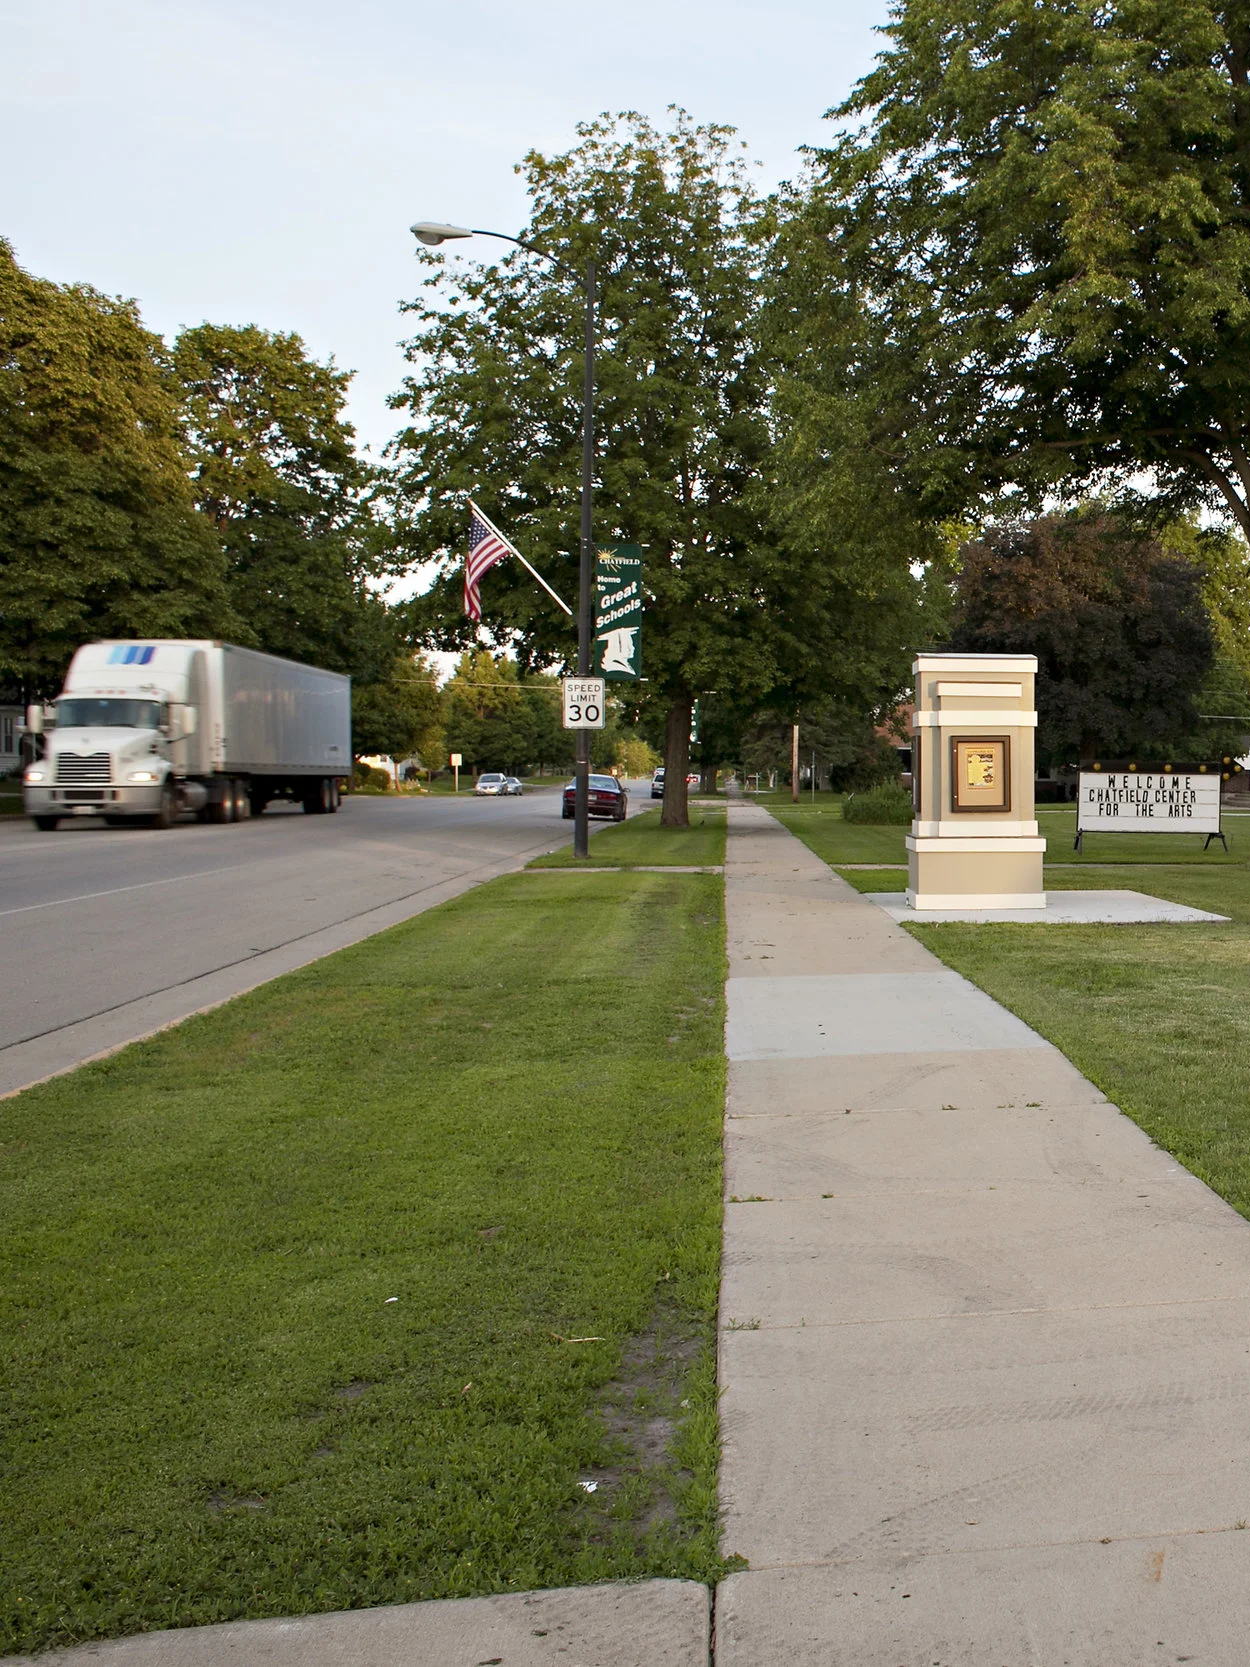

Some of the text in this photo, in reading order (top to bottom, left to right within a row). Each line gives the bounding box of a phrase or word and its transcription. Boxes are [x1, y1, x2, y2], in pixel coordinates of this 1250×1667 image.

[597, 575, 621, 583] Home
[597, 584, 606, 592] to
[600, 581, 638, 609] Great
[596, 597, 641, 629] Schools
[567, 684, 601, 692] SPEED
[571, 694, 597, 702] LIMIT
[569, 704, 600, 722] 30
[1108, 775, 1191, 789] WELCOME
[1089, 789, 1196, 803] CHATFIELD CENTER
[1099, 803, 1192, 817] FOR THE ARTS
